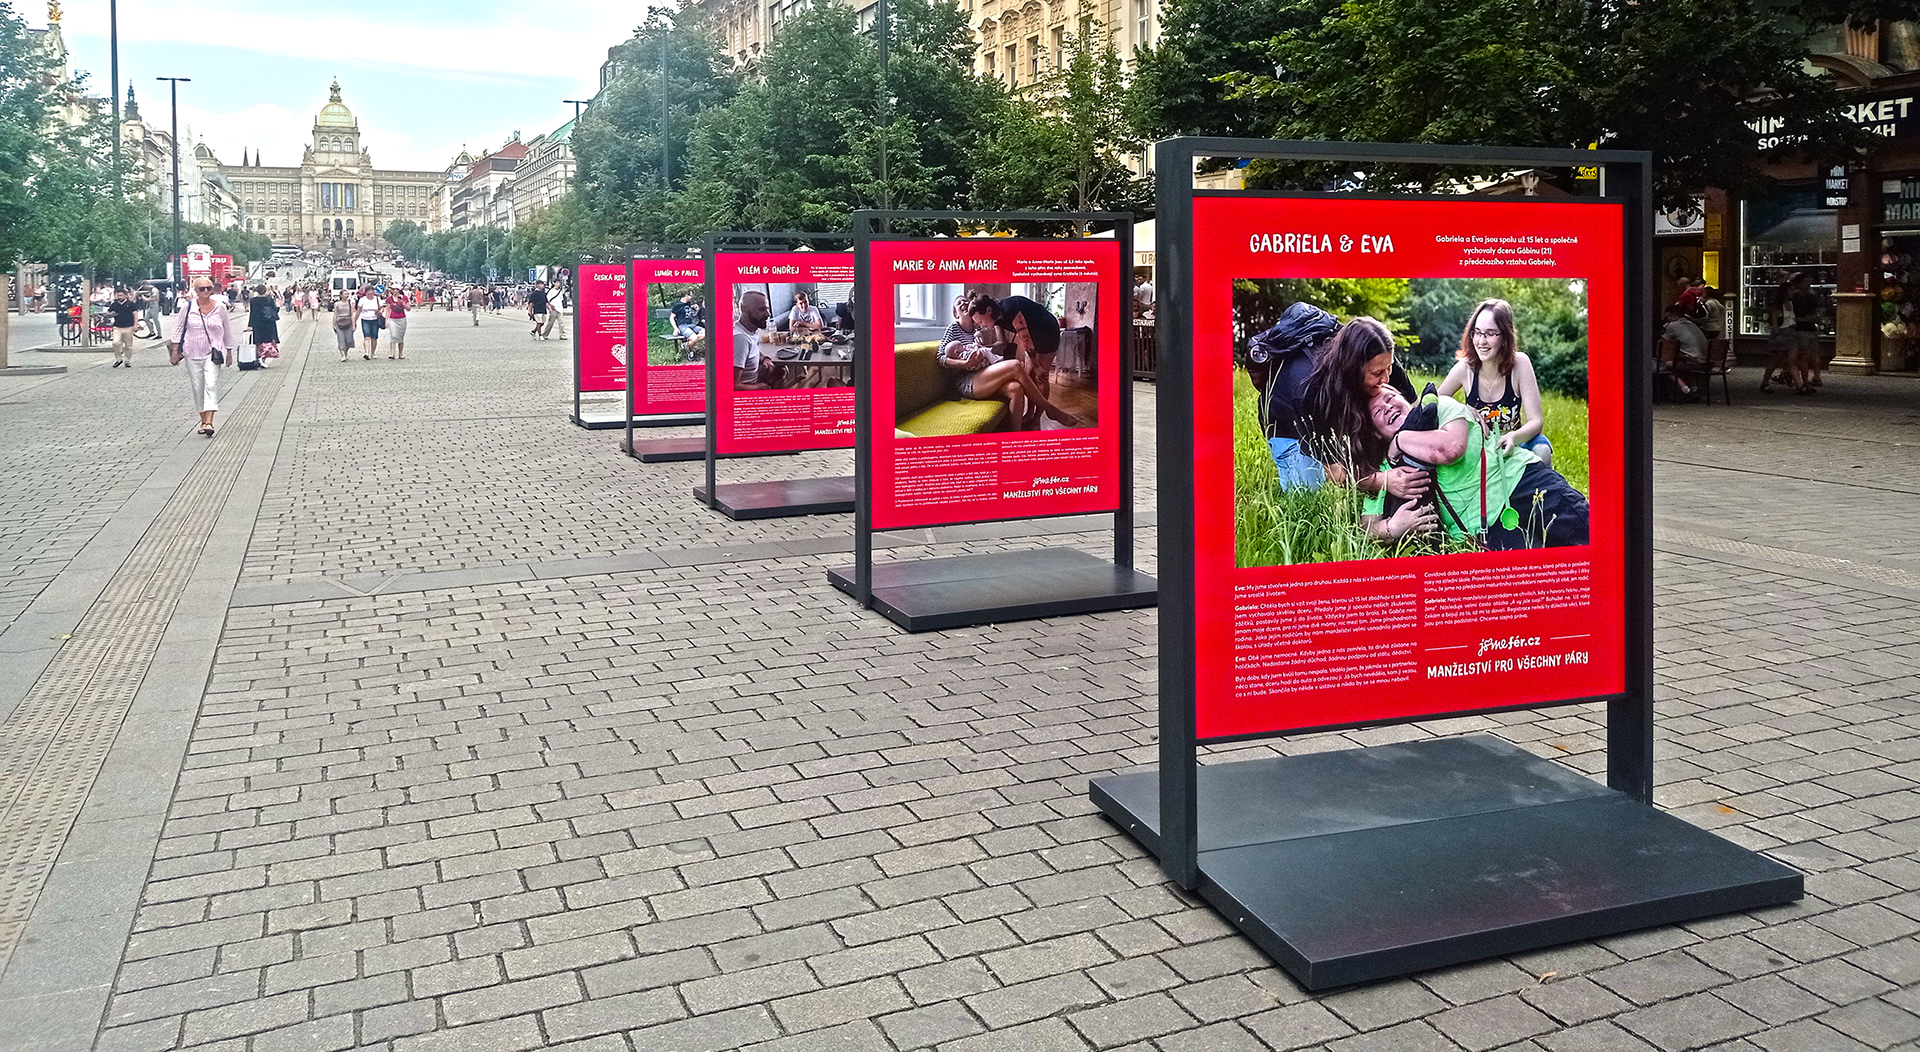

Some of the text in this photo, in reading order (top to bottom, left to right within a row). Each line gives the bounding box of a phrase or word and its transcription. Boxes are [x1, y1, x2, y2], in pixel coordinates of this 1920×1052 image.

[1818, 97, 1913, 124] RKET
[1826, 179, 1848, 189] MARKET
[1826, 197, 1848, 206] NONSTOP
[1250, 233, 1393, 253] GABRIELA & EVA
[1485, 236, 1498, 244] jsou
[1500, 236, 1516, 245] spolu
[1550, 236, 1578, 245] společně
[1464, 247, 1495, 255] vychovaly
[894, 260, 998, 271] MARIE & ANNA MARIE
[1464, 258, 1504, 266] předchozího
[1528, 259, 1556, 267] Gabriely.
[738, 265, 760, 274] VILÉM
[772, 265, 799, 274] ONDŘEJ
[594, 273, 612, 281] ČESKÁ
[1003, 485, 1098, 499] MANŽELSTVÍ PRO VŠECHNY PÁRY
[1427, 650, 1589, 679] MANŽELSTVÍ PRO VŠECHNY PÁRY
